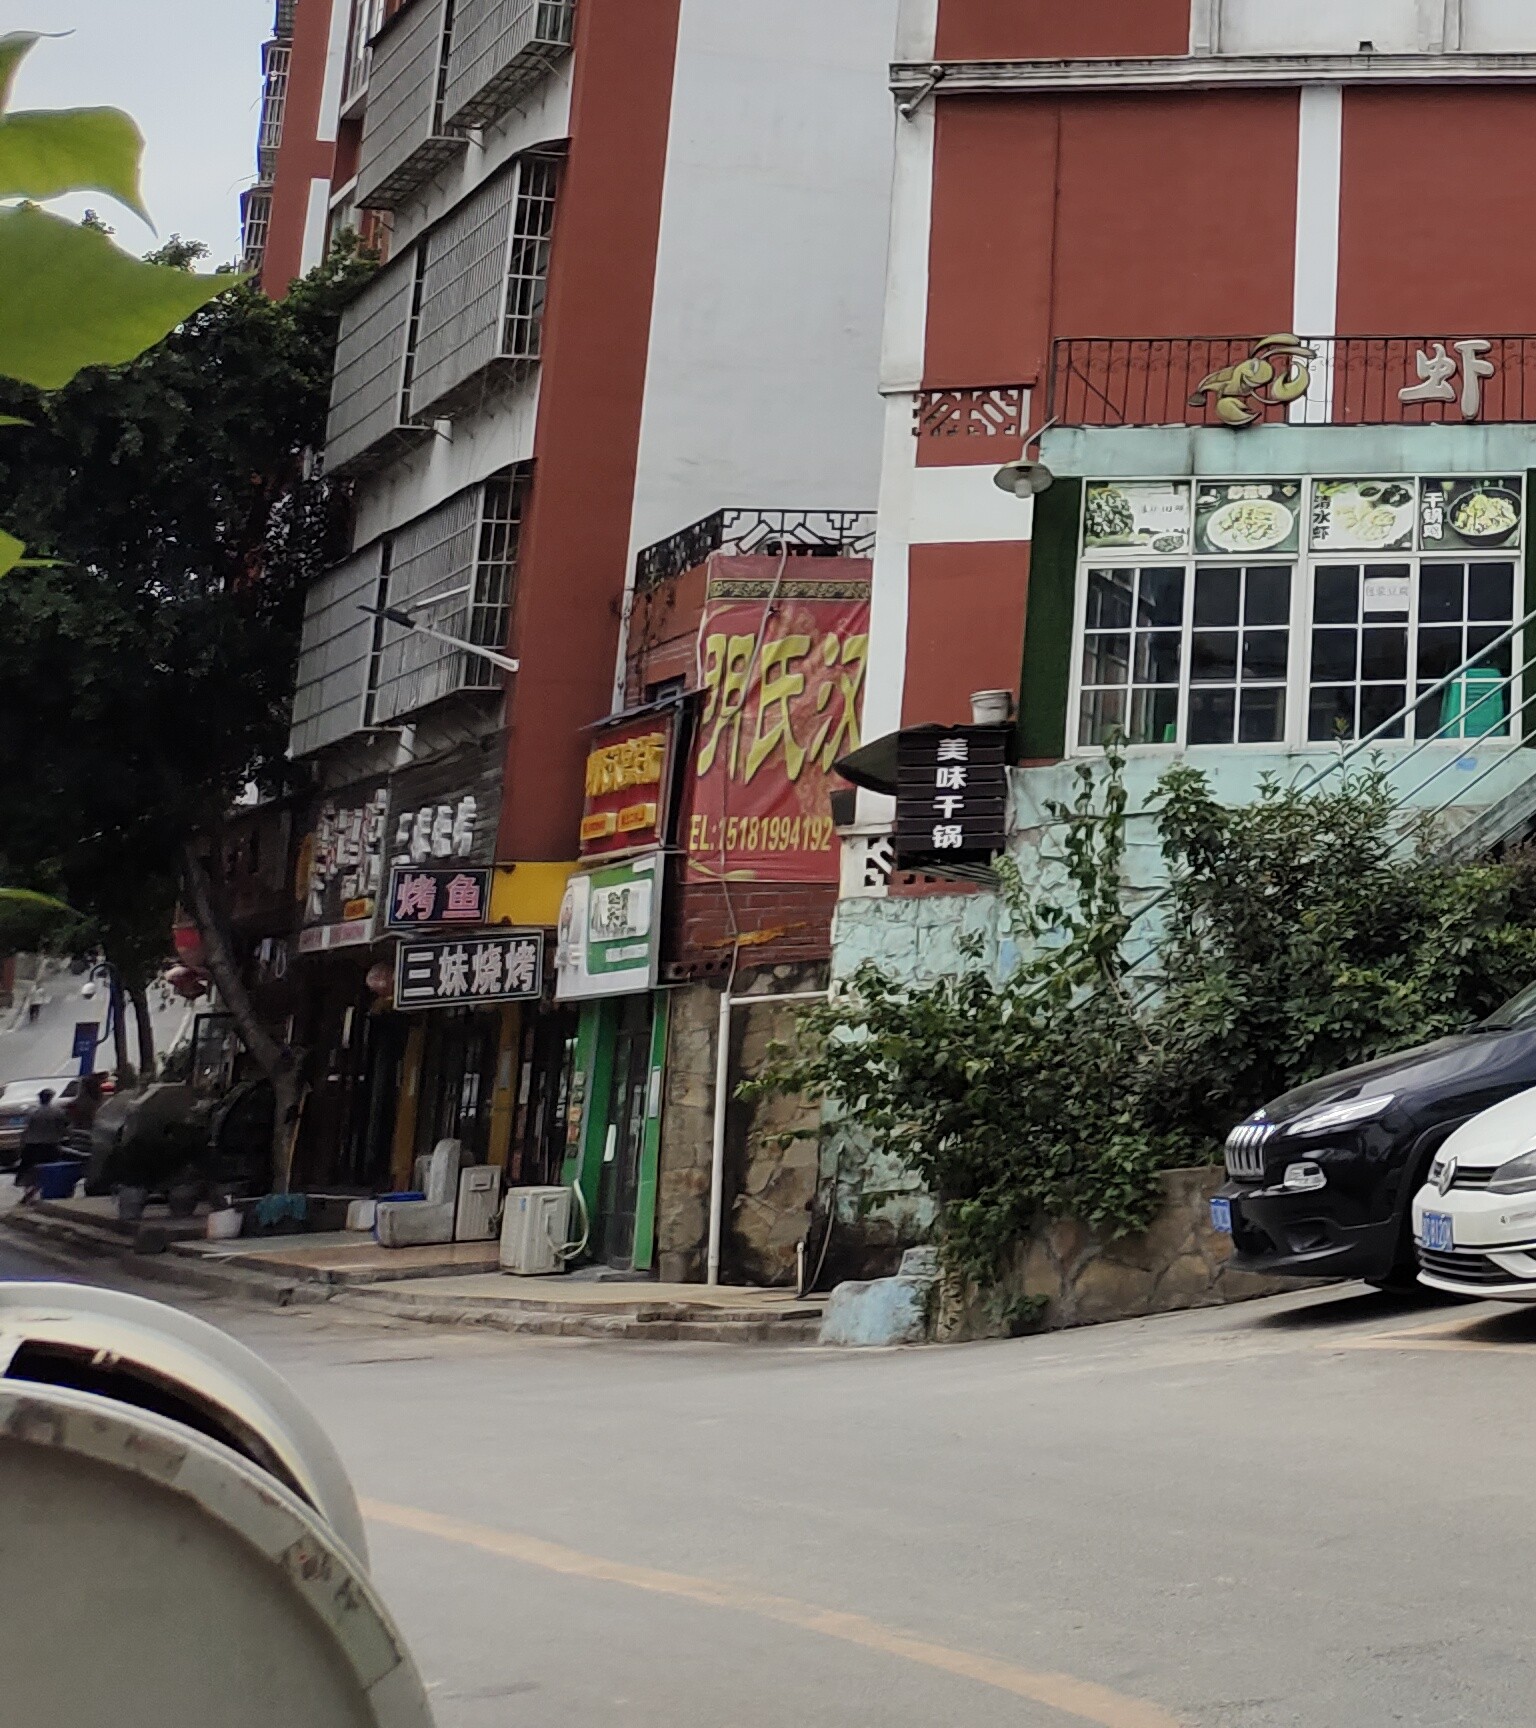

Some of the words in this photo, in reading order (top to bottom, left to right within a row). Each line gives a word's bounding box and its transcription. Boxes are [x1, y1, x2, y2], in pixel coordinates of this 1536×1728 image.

[932, 738, 969, 849] 美味干锅
[395, 873, 481, 920] 烤鱼
[403, 940, 537, 998] 三妹烧烤
